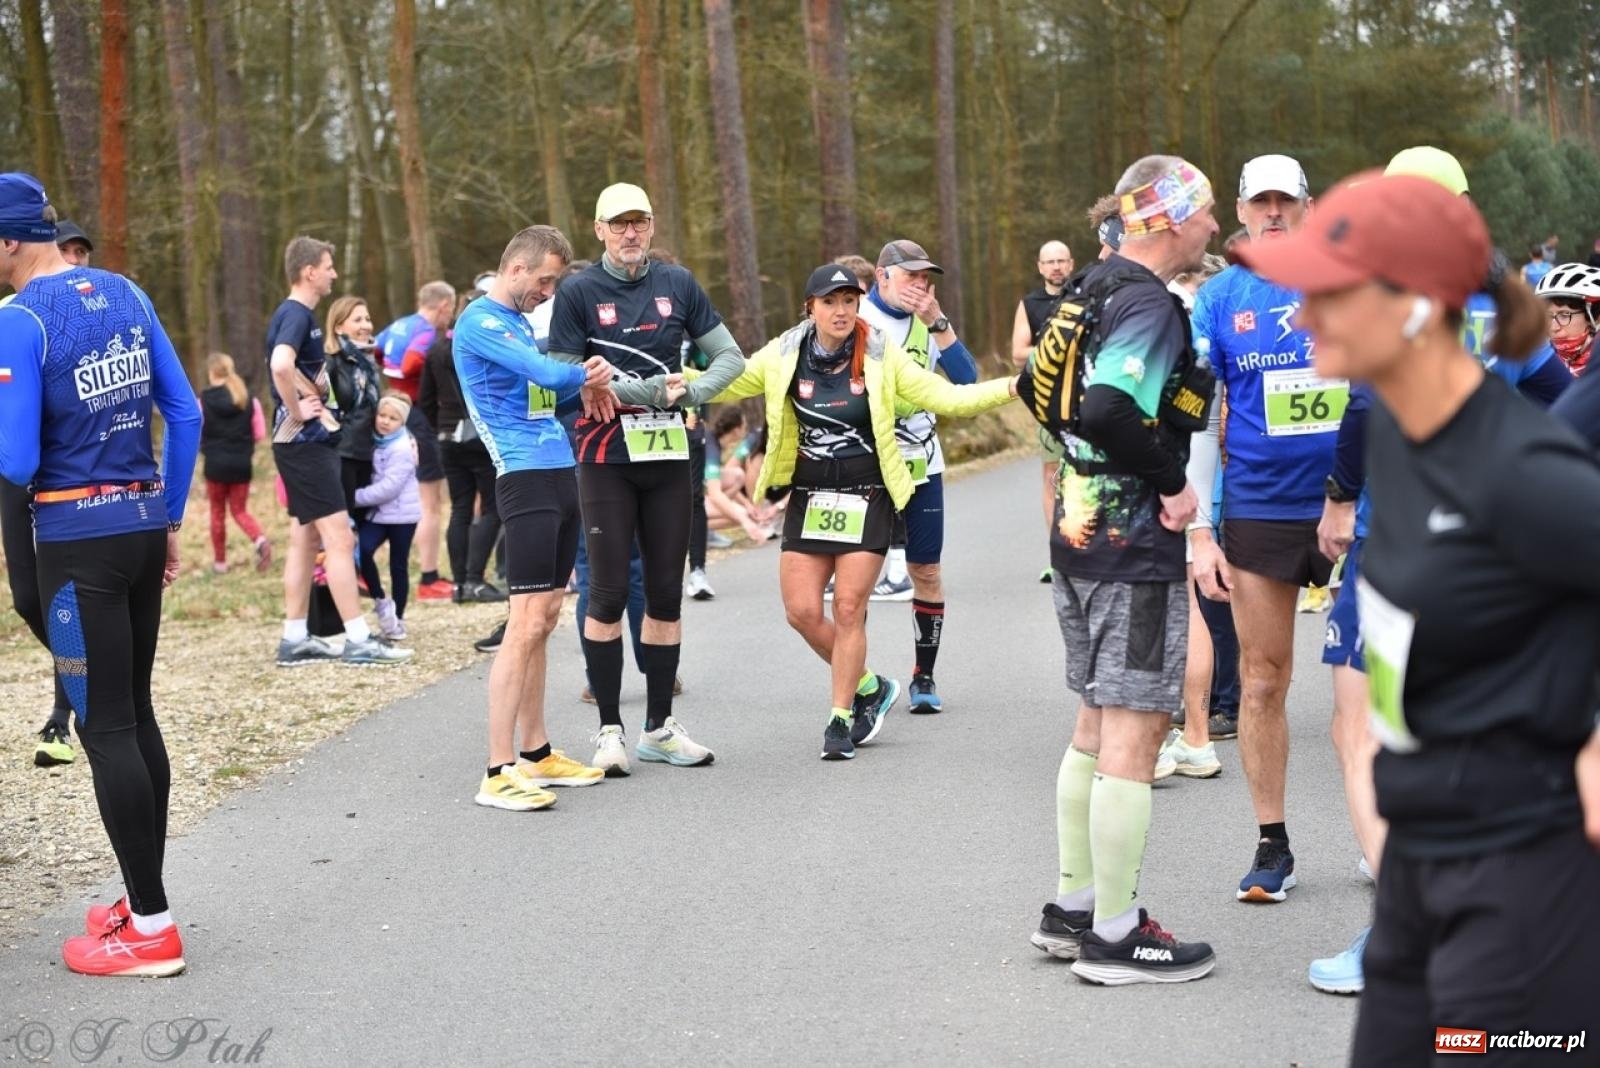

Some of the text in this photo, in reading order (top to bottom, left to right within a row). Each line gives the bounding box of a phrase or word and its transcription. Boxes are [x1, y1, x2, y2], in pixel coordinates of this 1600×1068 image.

[1236, 350, 1298, 372] HRmax
[78, 351, 149, 395] SILESIAN
[85, 387, 130, 414] TRIATHLON
[1289, 391, 1330, 422] 56
[643, 430, 673, 451] 71
[818, 510, 847, 532] 38
[1133, 946, 1174, 961] HOKA
